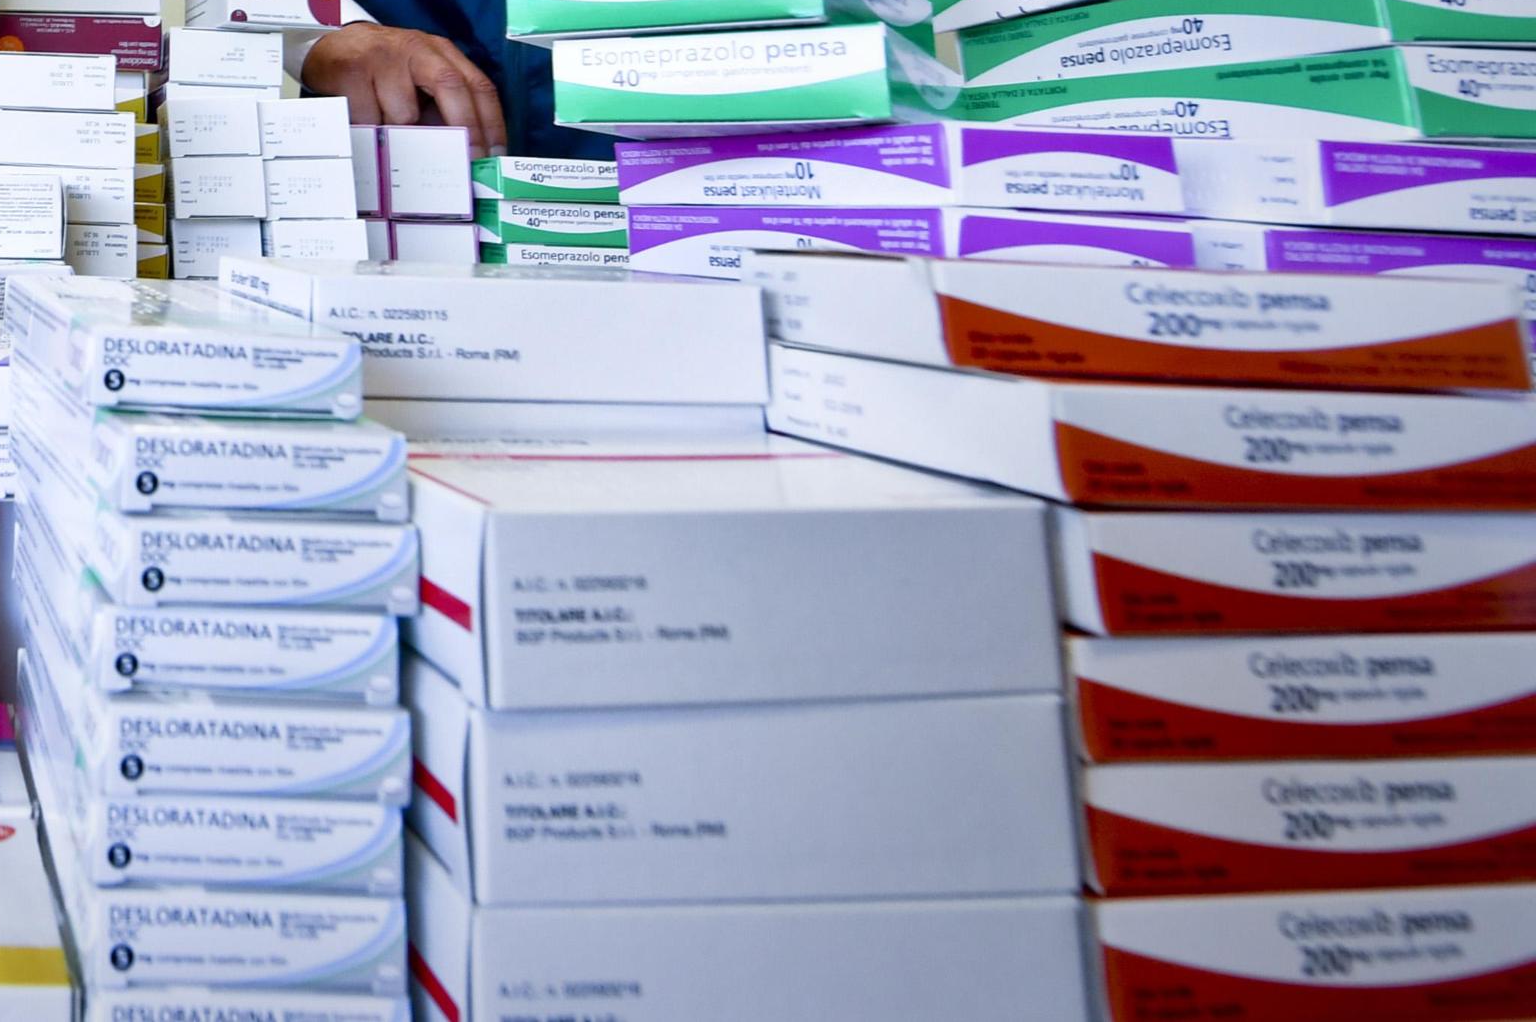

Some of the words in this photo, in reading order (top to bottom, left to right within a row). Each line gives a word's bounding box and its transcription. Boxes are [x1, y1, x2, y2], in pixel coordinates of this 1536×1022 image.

[581, 39, 754, 68] Esomeprazolo
[765, 39, 847, 63] pensa
[1060, 47, 1105, 70] pensa
[1109, 33, 1231, 61] Esomeprazolo
[514, 161, 594, 175] Esomeprazolo
[704, 184, 737, 197] pensa
[739, 186, 820, 200] Montelukast
[1005, 182, 1048, 197] pensa
[1053, 184, 1144, 202] Montelukast
[512, 205, 590, 219] Esomeprazolo
[521, 249, 600, 263] Esomeprazolo
[709, 255, 741, 268] pensa
[1125, 282, 1251, 309] Celecoxib
[1256, 293, 1331, 314] pensa
[104, 336, 248, 360] DESLORATADINA
[456, 348, 490, 360] Roma
[1224, 403, 1331, 430] Celecoxib
[1338, 414, 1405, 435] pensa
[136, 436, 287, 460] DESLORATADINA
[141, 530, 295, 553] DESLORATADINA
[1251, 528, 1354, 555] Celecoxib
[1360, 533, 1426, 557] pensa
[114, 615, 272, 640] DESLORATADINA
[1248, 651, 1359, 679] Celecoxib
[1364, 656, 1437, 681] pensa
[120, 718, 280, 740] DESLORATADINA
